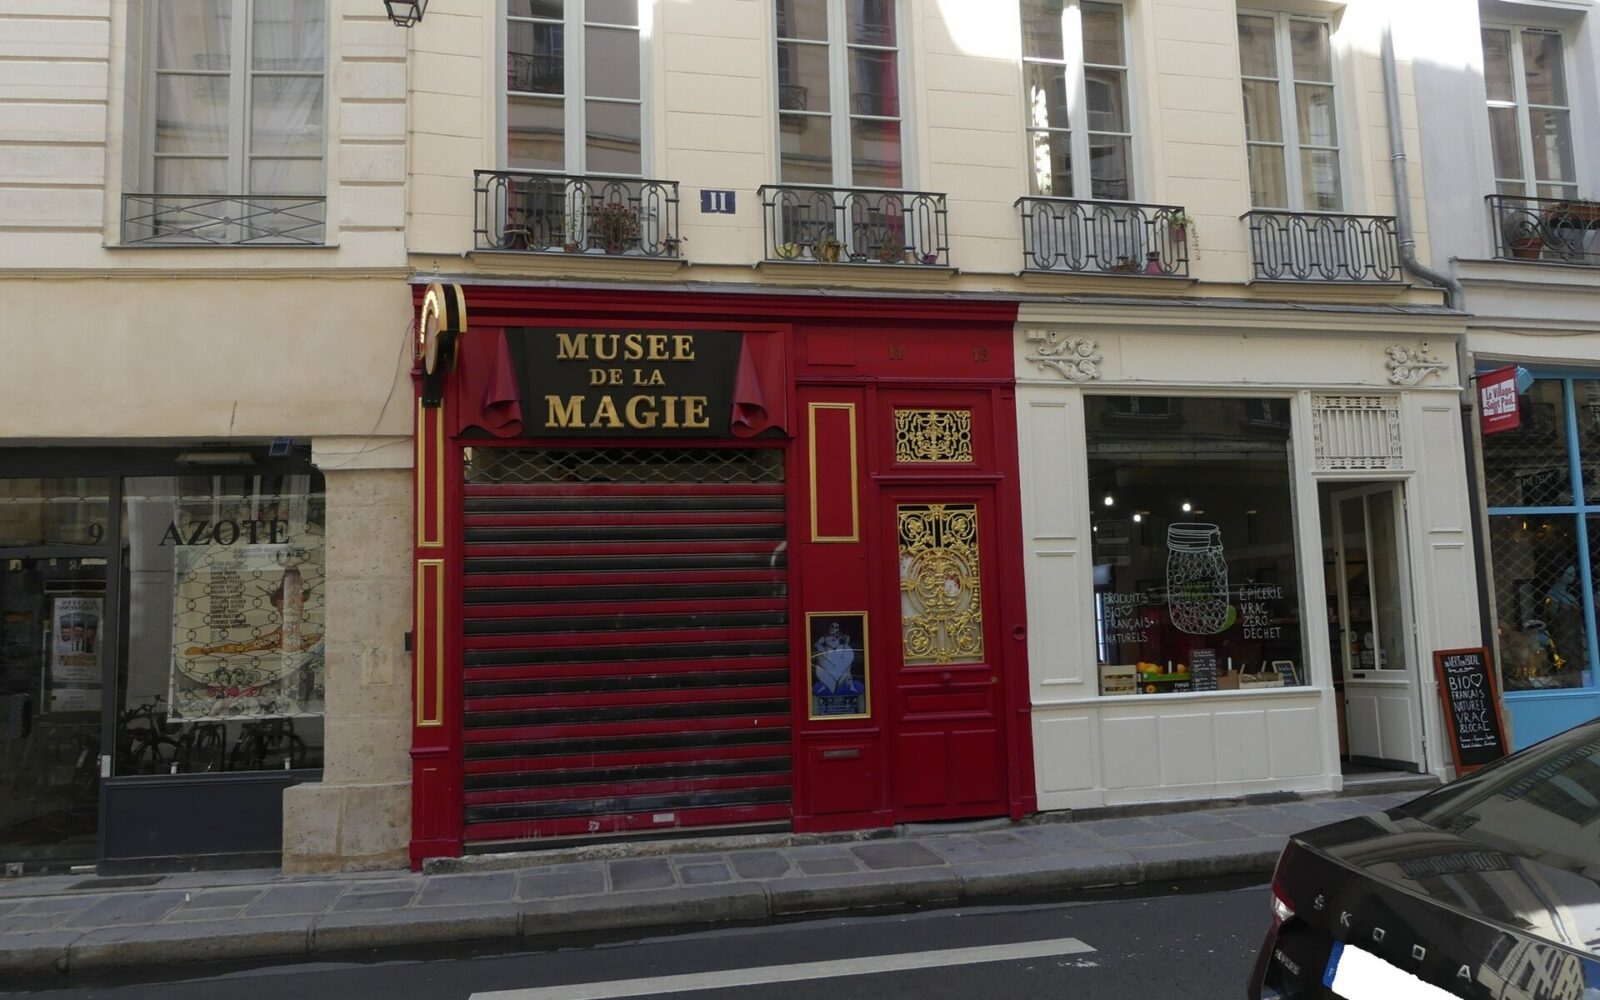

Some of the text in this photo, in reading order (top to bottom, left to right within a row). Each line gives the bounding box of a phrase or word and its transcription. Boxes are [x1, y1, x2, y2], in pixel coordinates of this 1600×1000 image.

[710, 191, 727, 211] 11
[555, 333, 696, 361] MUSEE
[589, 368, 666, 386] DE LA
[545, 395, 710, 429] MAGIE
[88, 522, 105, 545] 9
[158, 520, 290, 546] AZOTE
[1103, 592, 1148, 604] PRODUITS
[1240, 601, 1268, 614] VRAC
[1105, 631, 1148, 644] NATURELS
[1453, 700, 1488, 712] NATUREL
[1456, 710, 1489, 724] VRAC
